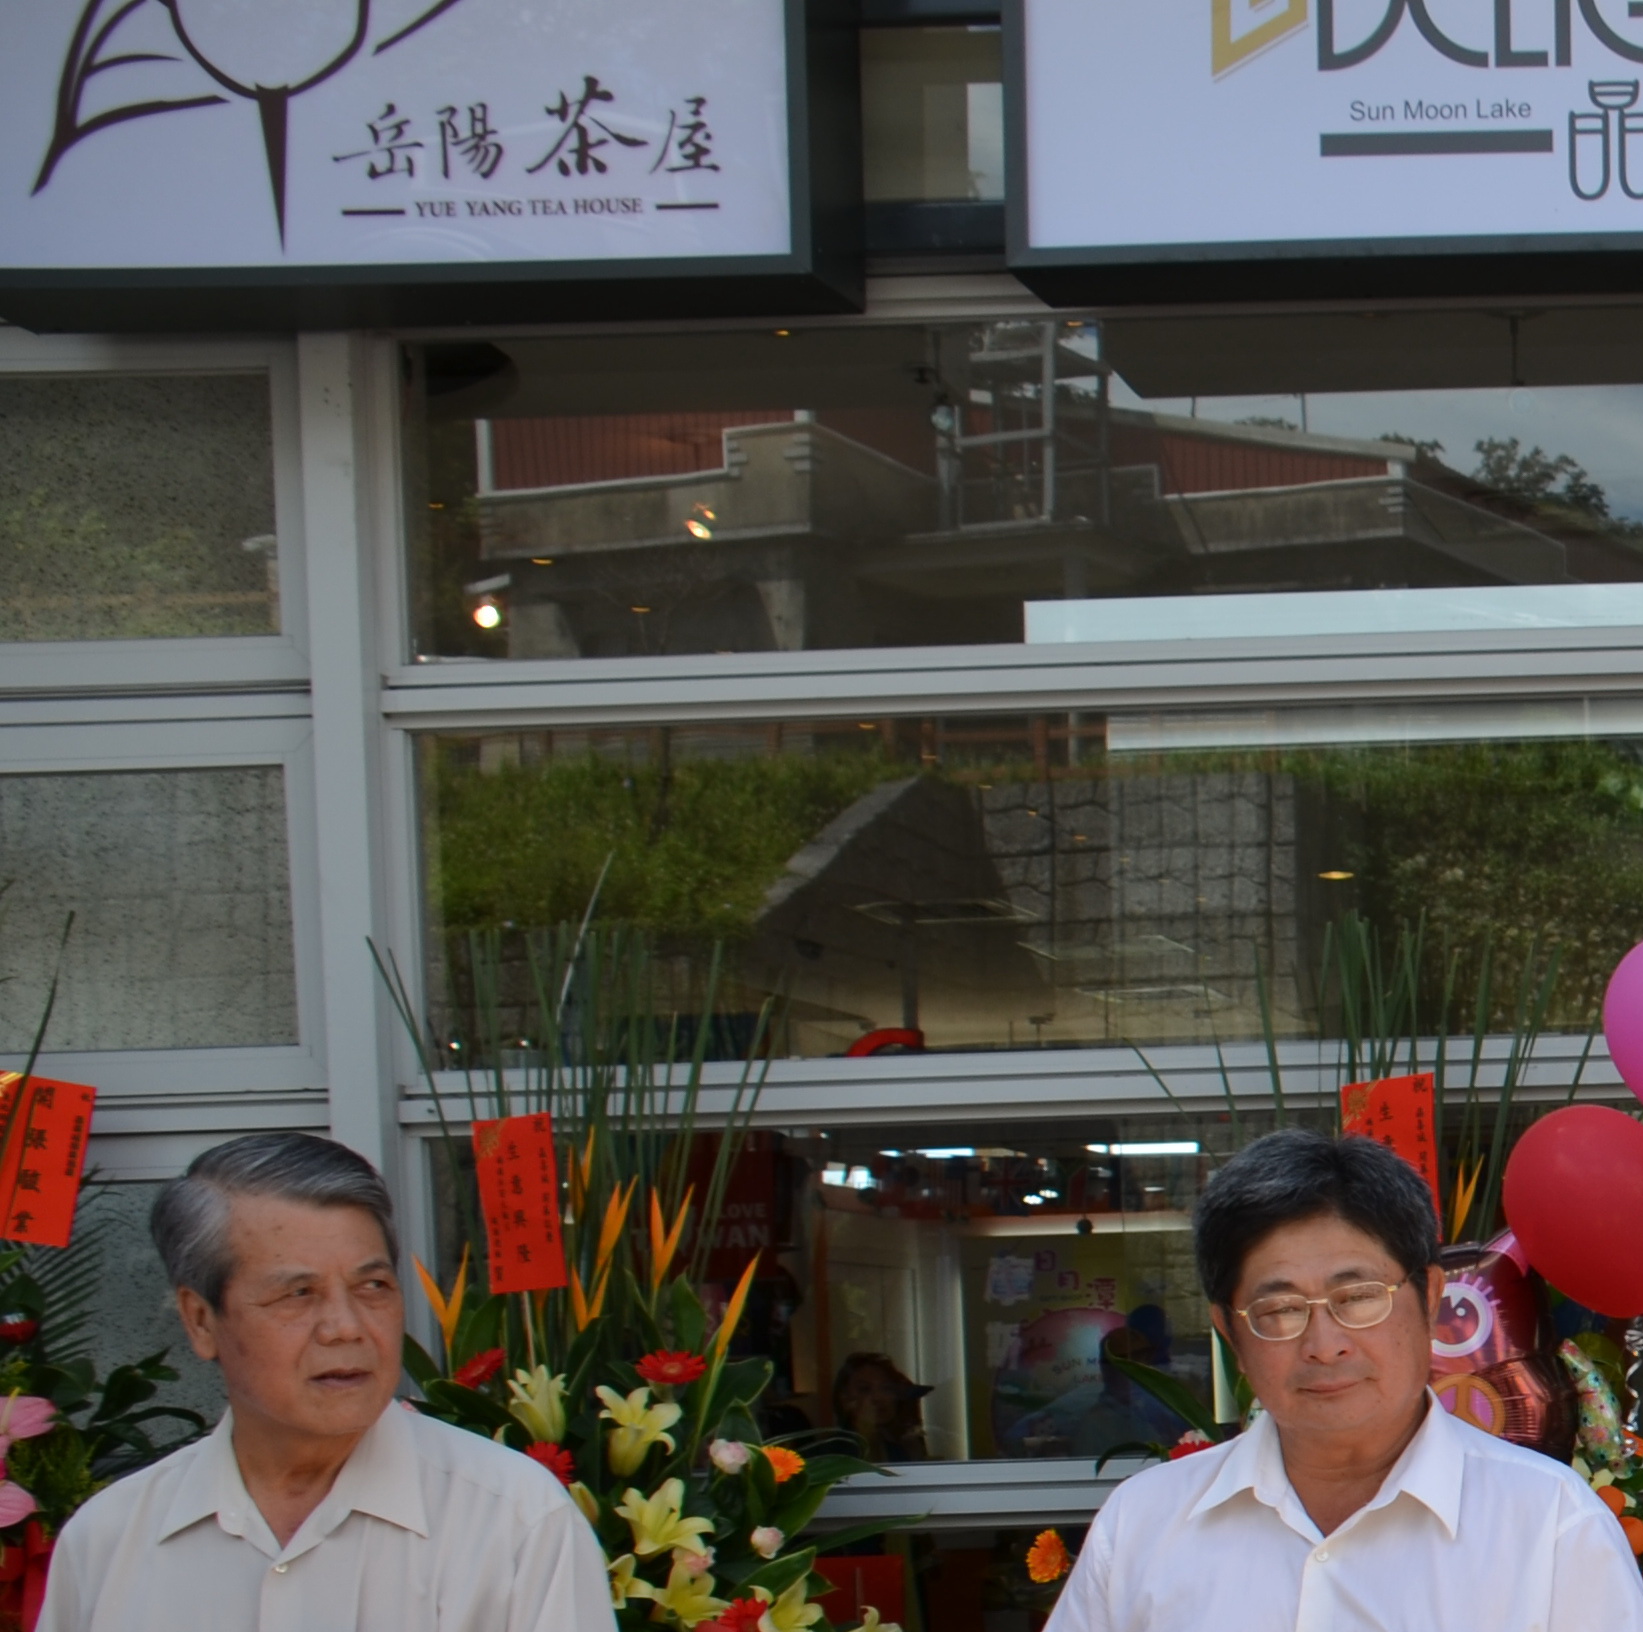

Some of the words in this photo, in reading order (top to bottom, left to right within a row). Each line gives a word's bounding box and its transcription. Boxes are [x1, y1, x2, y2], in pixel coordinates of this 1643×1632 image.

[1349, 100, 1396, 121] Sun
[1403, 99, 1468, 120] Moon
[1475, 98, 1532, 119] Lake
[333, 75, 721, 180] 岳陽茶屋
[415, 201, 457, 218] YUE
[466, 200, 522, 217] YANG
[528, 199, 567, 216] TEA
[573, 198, 643, 215] HOUSE
